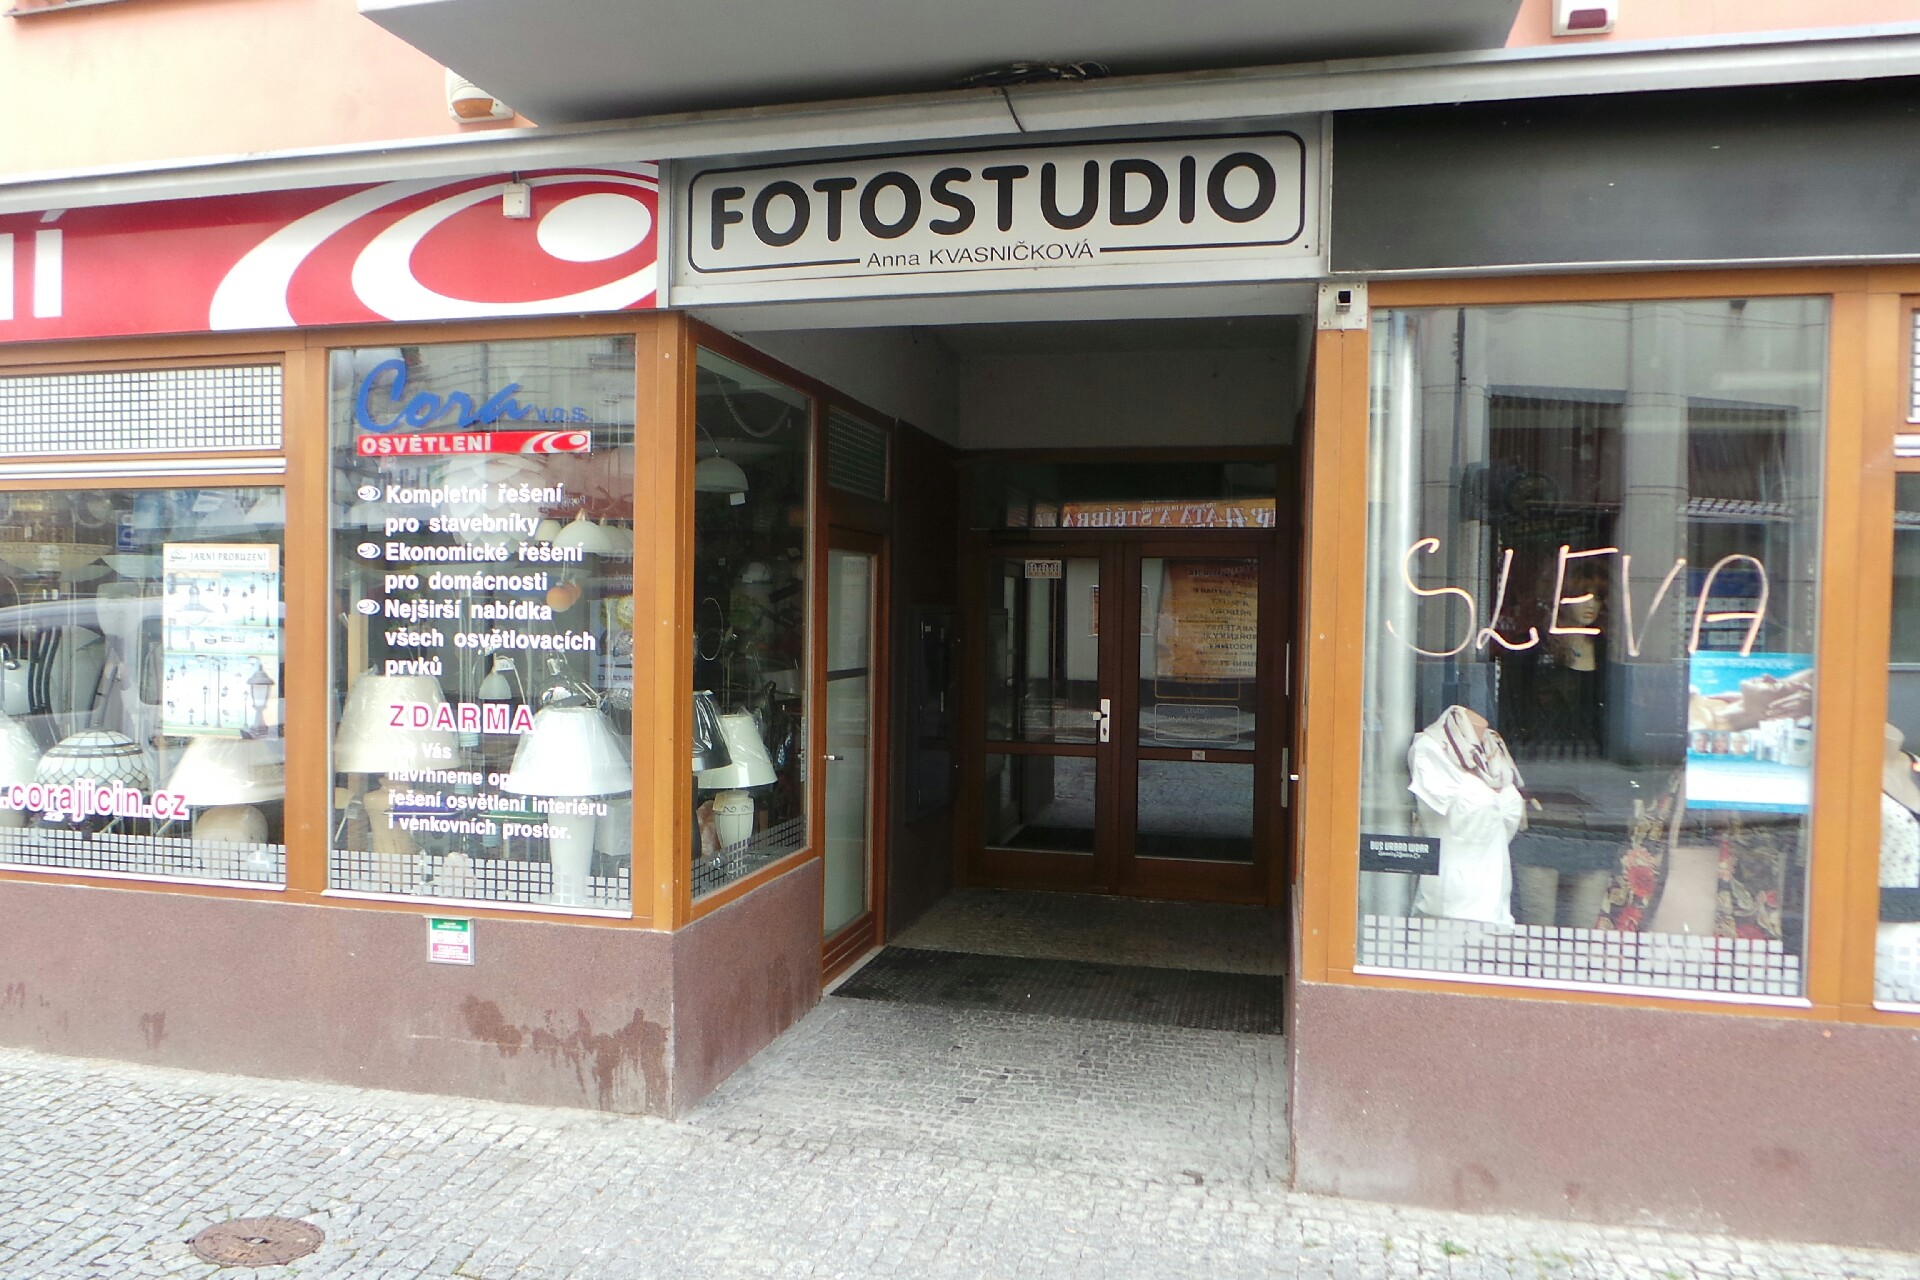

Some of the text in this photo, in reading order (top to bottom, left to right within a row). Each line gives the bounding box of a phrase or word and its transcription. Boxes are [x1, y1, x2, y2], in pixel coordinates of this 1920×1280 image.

[711, 152, 1276, 250] FOTOSTUDIO
[866, 239, 1094, 268] Anna KVASNIČKOVÁ
[356, 359, 532, 433] Cora
[362, 433, 491, 453] OSVĚTLENÍ
[387, 483, 488, 507] Kompletní
[498, 483, 563, 503] řešení
[385, 514, 539, 537] pro stavebníky
[385, 542, 508, 562] Ekonomické
[518, 541, 584, 562] řešení
[385, 571, 548, 593] pro domácnosti
[1387, 538, 1769, 656] SLEVA
[384, 598, 552, 622] Nejširší nabídka
[384, 627, 596, 651] všech osvětlovacích
[385, 656, 443, 677] prvků
[389, 703, 535, 733] ZDARMA
[422, 743, 452, 759] Vás
[388, 768, 483, 785] navrhneme
[388, 789, 607, 816] řešení osvětlení interiéru
[399, 817, 496, 835] venkovních
[502, 822, 571, 839] prostor.
